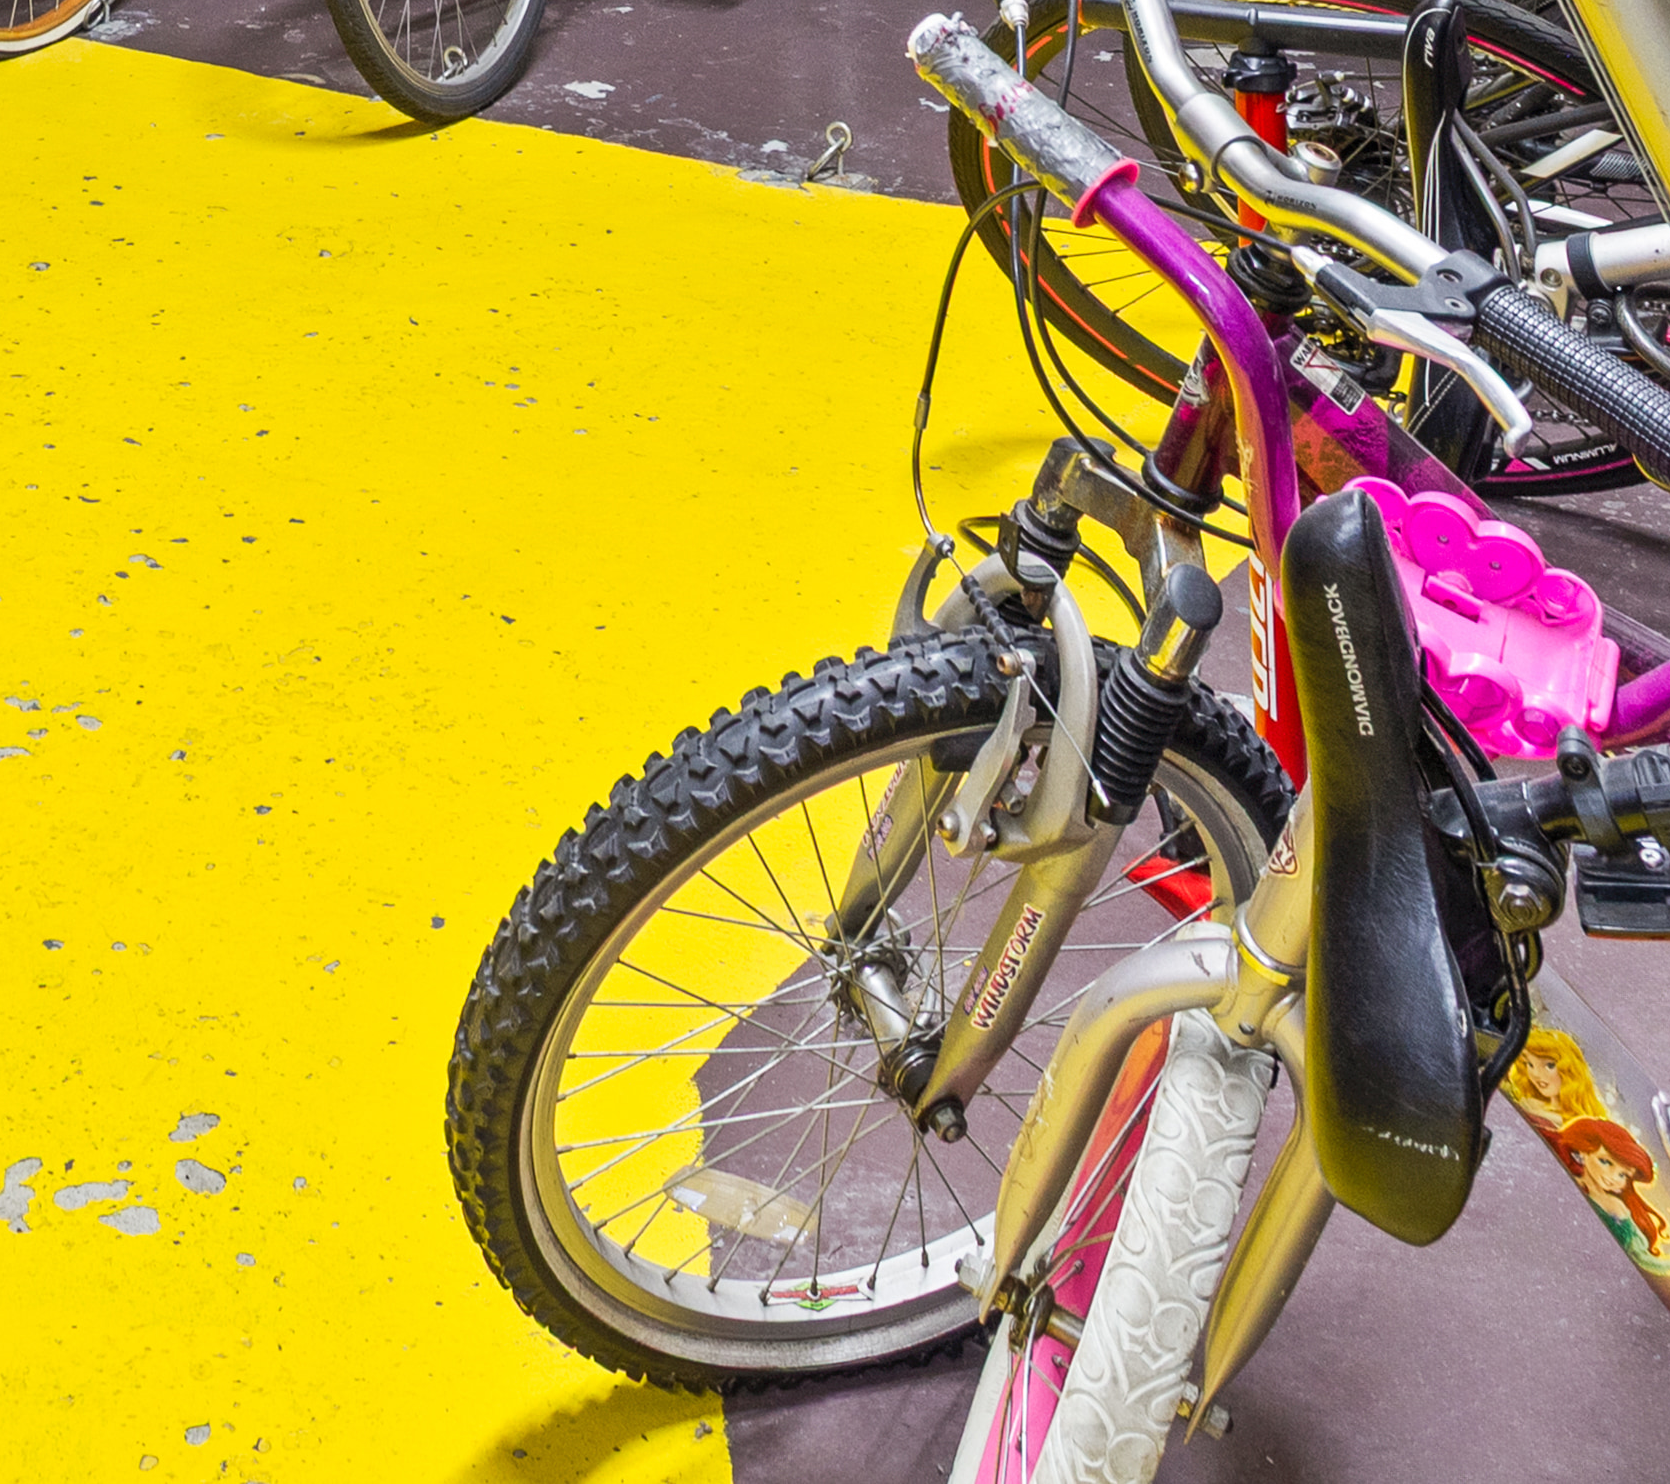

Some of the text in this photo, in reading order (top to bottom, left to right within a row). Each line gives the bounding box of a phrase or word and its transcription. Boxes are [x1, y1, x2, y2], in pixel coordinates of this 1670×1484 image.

[1273, 194, 1318, 210] HORIZON
[1552, 442, 1619, 465] ALUMINUM
[1324, 582, 1374, 737] DIAMONDBACK
[972, 903, 1045, 1031] WINDSTORM
